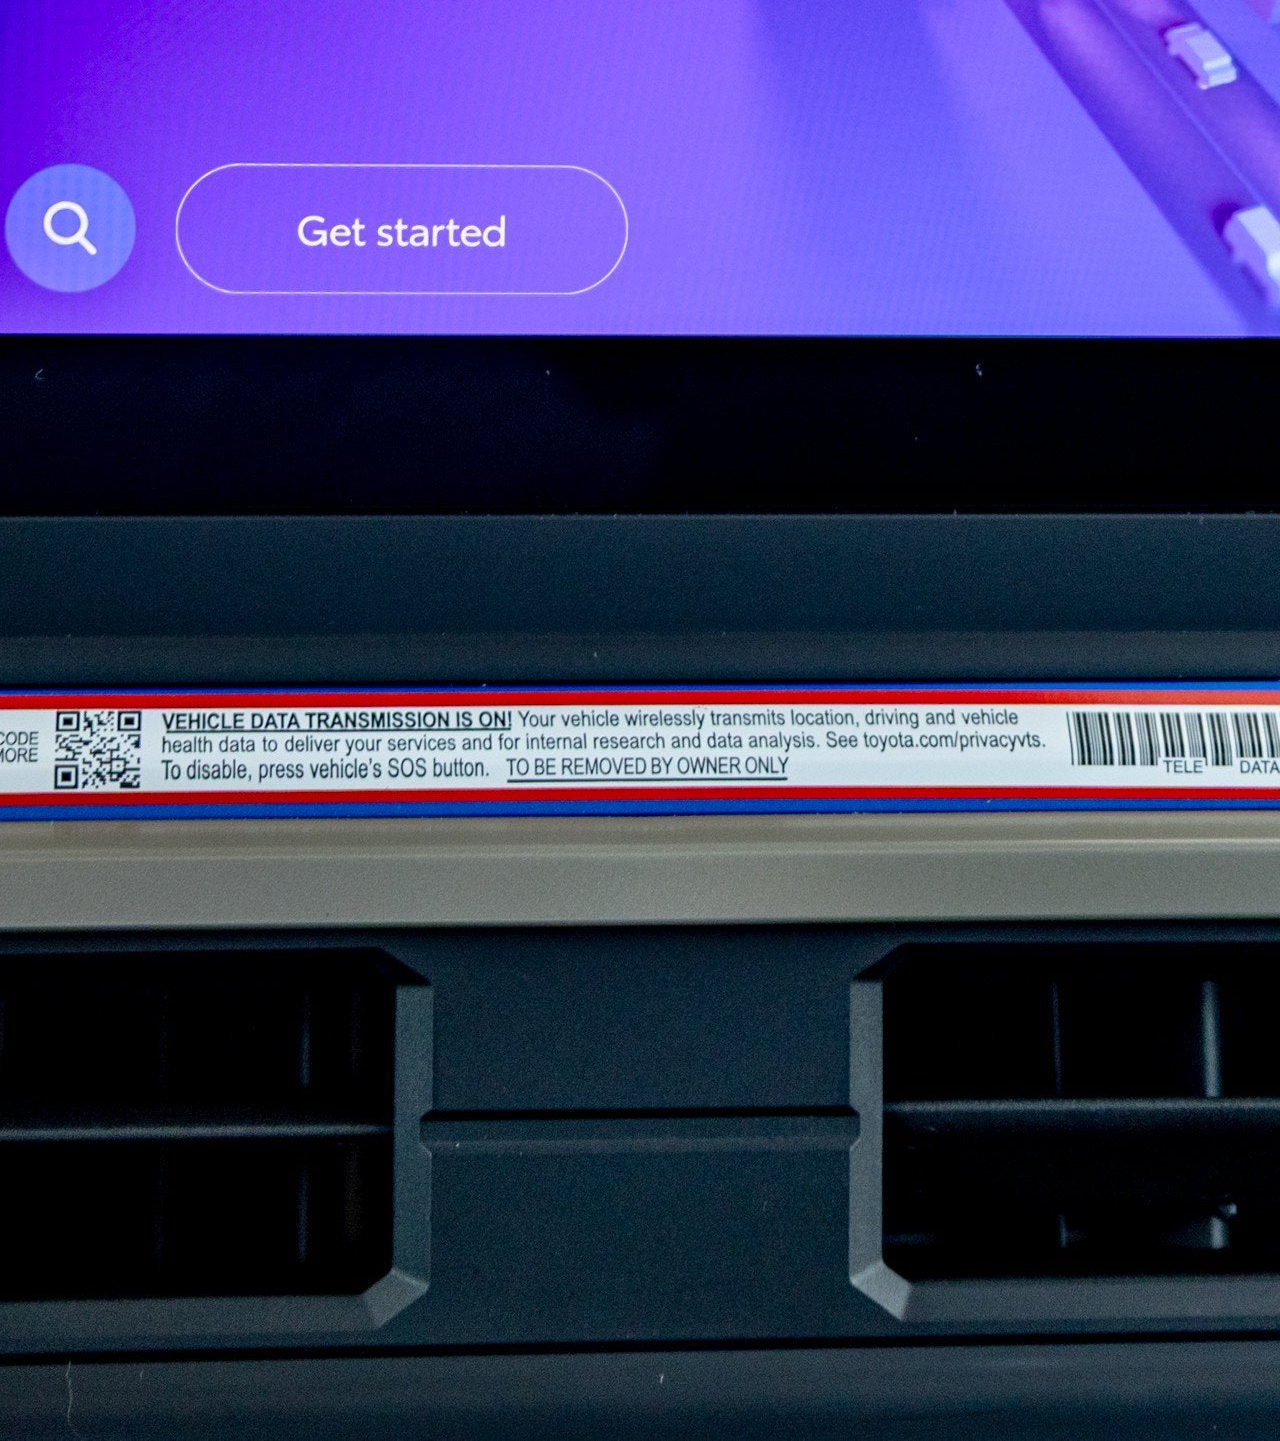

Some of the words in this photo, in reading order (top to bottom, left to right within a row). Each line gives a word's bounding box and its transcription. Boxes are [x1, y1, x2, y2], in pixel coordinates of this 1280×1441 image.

[297, 214, 366, 248] Get
[376, 214, 507, 248] started
[162, 713, 246, 730] VEHICLE
[251, 713, 300, 730] DATA
[305, 712, 450, 730] TRANSMISSION
[456, 711, 473, 729] IS
[479, 711, 513, 729] ON!
[518, 710, 557, 727] Your
[561, 710, 620, 727] vehicle
[624, 710, 706, 730] wirelessly
[710, 710, 786, 726] transmits
[791, 709, 860, 728] location,
[865, 709, 920, 729] driving
[925, 709, 956, 726] and
[961, 709, 1019, 726] vehicle
[161, 736, 214, 753] health
[219, 736, 257, 753] data
[261, 736, 277, 753] to
[284, 735, 340, 752] deliver
[345, 736, 382, 756] your
[387, 735, 456, 751] services
[461, 734, 492, 751] and
[498, 734, 520, 750] for
[526, 733, 587, 750] internal
[592, 733, 666, 750] research
[671, 733, 701, 749] and
[706, 732, 742, 749] data
[748, 732, 820, 753] analysis.
[825, 732, 858, 748] See
[863, 732, 1046, 753] toyota.com/privacyvts.
[161, 760, 182, 780] To
[186, 760, 252, 782] disable,
[258, 764, 304, 784] press
[387, 758, 427, 778] SOS
[433, 758, 490, 778] button.
[507, 758, 530, 776] TO
[534, 758, 557, 776] BE
[561, 758, 647, 776] REMOVED
[651, 757, 672, 775] BY
[677, 757, 741, 775] OWNER
[745, 756, 790, 775] ONLY
[1163, 759, 1203, 774] TELE
